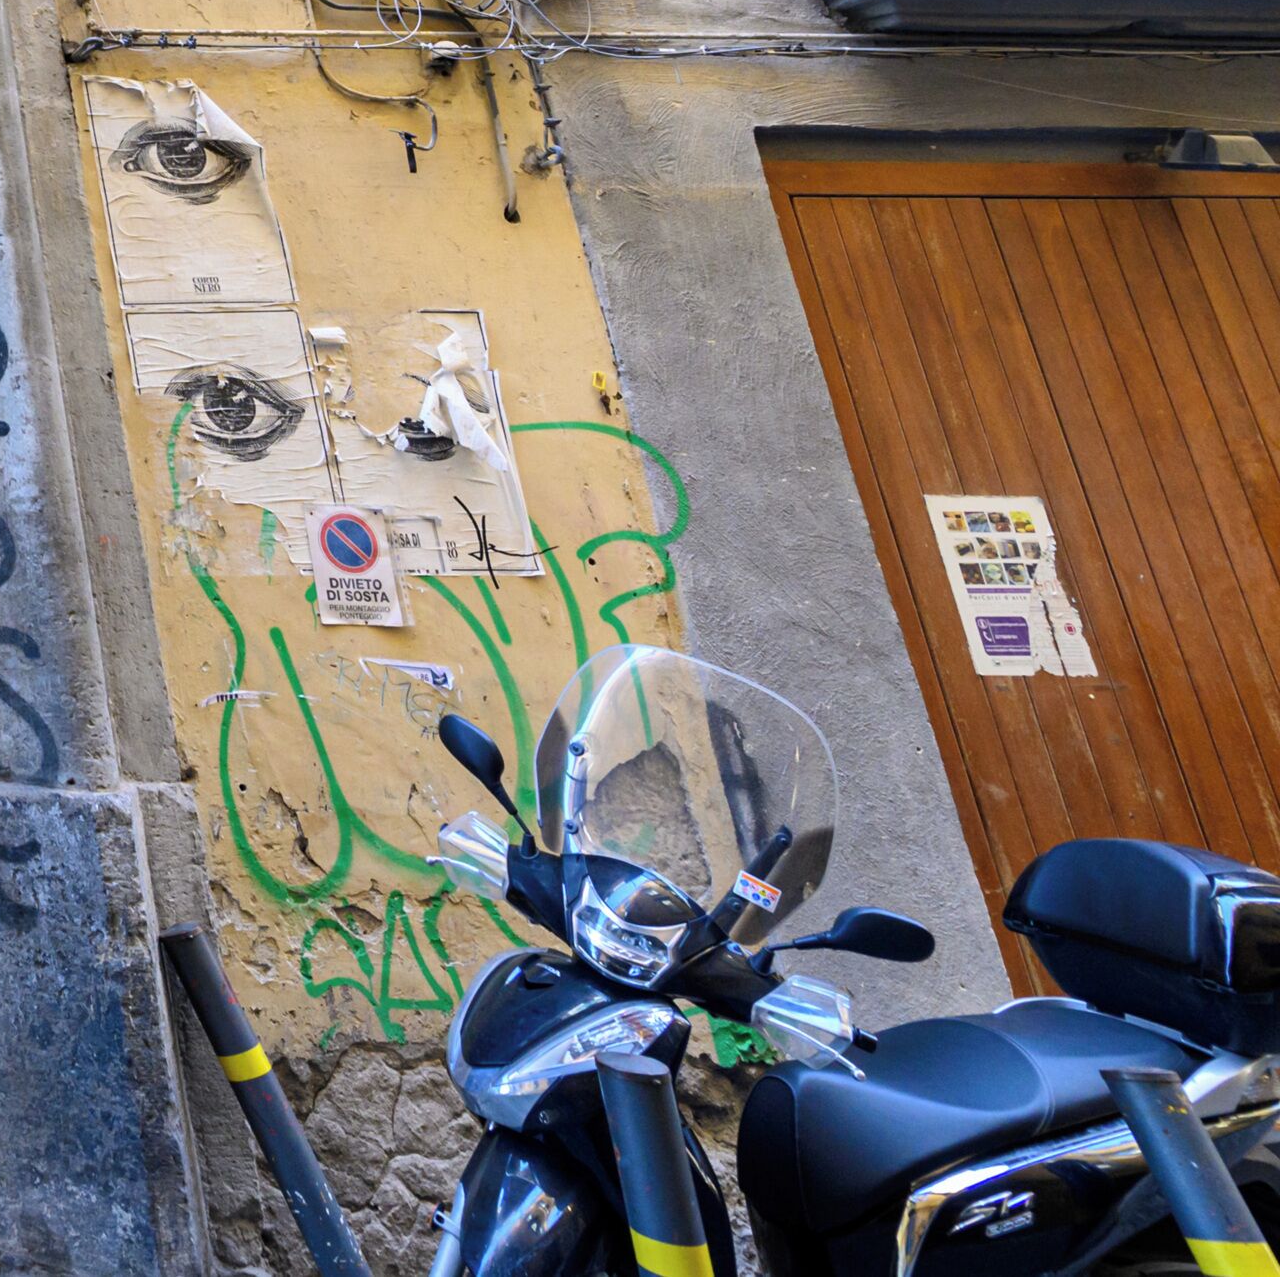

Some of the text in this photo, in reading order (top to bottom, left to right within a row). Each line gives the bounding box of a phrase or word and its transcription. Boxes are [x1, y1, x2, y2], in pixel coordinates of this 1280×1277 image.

[329, 577, 382, 590] DIVIETO
[326, 590, 390, 603] DI SOSTA
[329, 604, 391, 613] PER MONTAGGIO
[339, 612, 383, 620] PONTEGGIO
